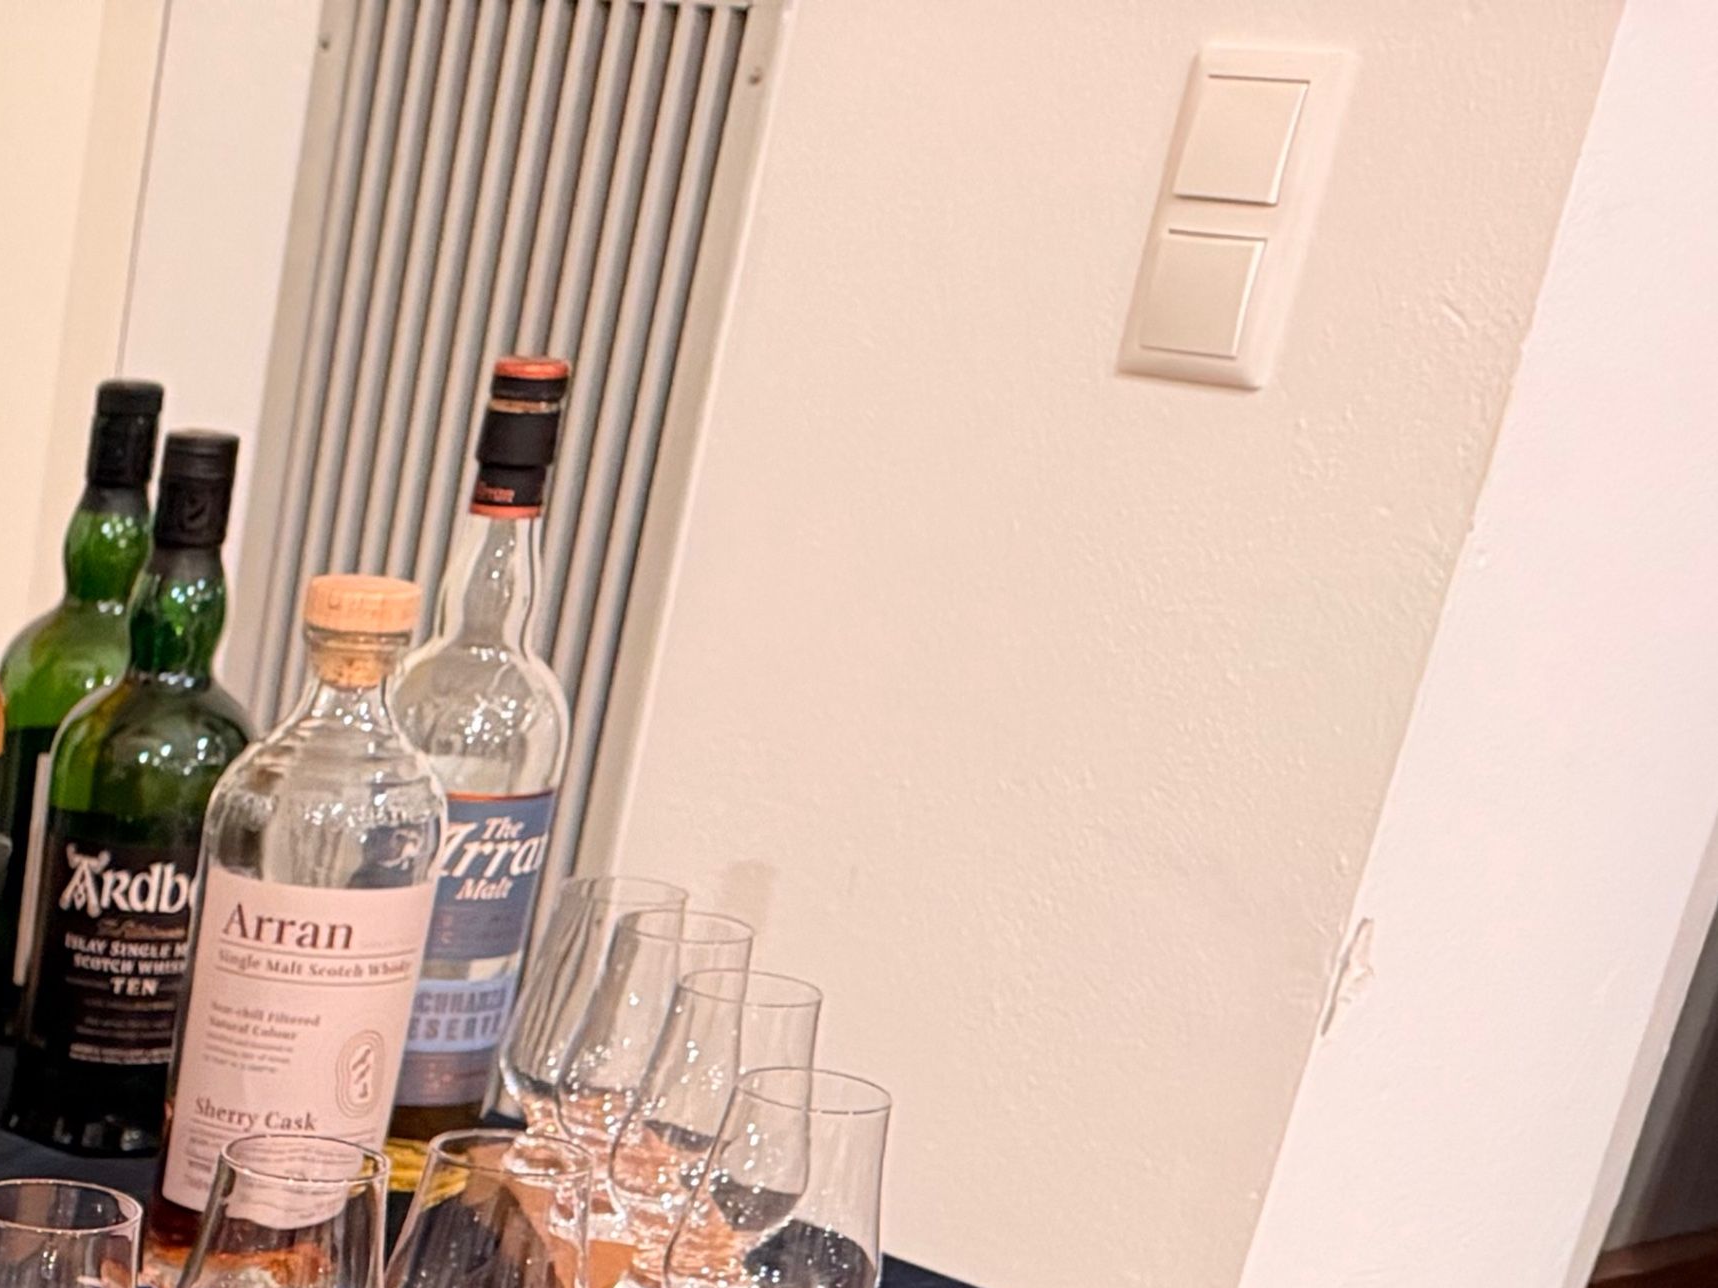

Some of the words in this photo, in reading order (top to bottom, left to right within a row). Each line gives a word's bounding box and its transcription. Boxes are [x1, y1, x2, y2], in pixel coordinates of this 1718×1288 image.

[483, 816, 524, 840] The
[456, 876, 513, 900] Malt
[220, 901, 354, 951] Arran
[266, 958, 302, 976] Malt
[309, 964, 364, 978] Scotch
[111, 976, 160, 996] TEN
[194, 1096, 259, 1132] Sherry
[264, 1111, 318, 1132] Cask
